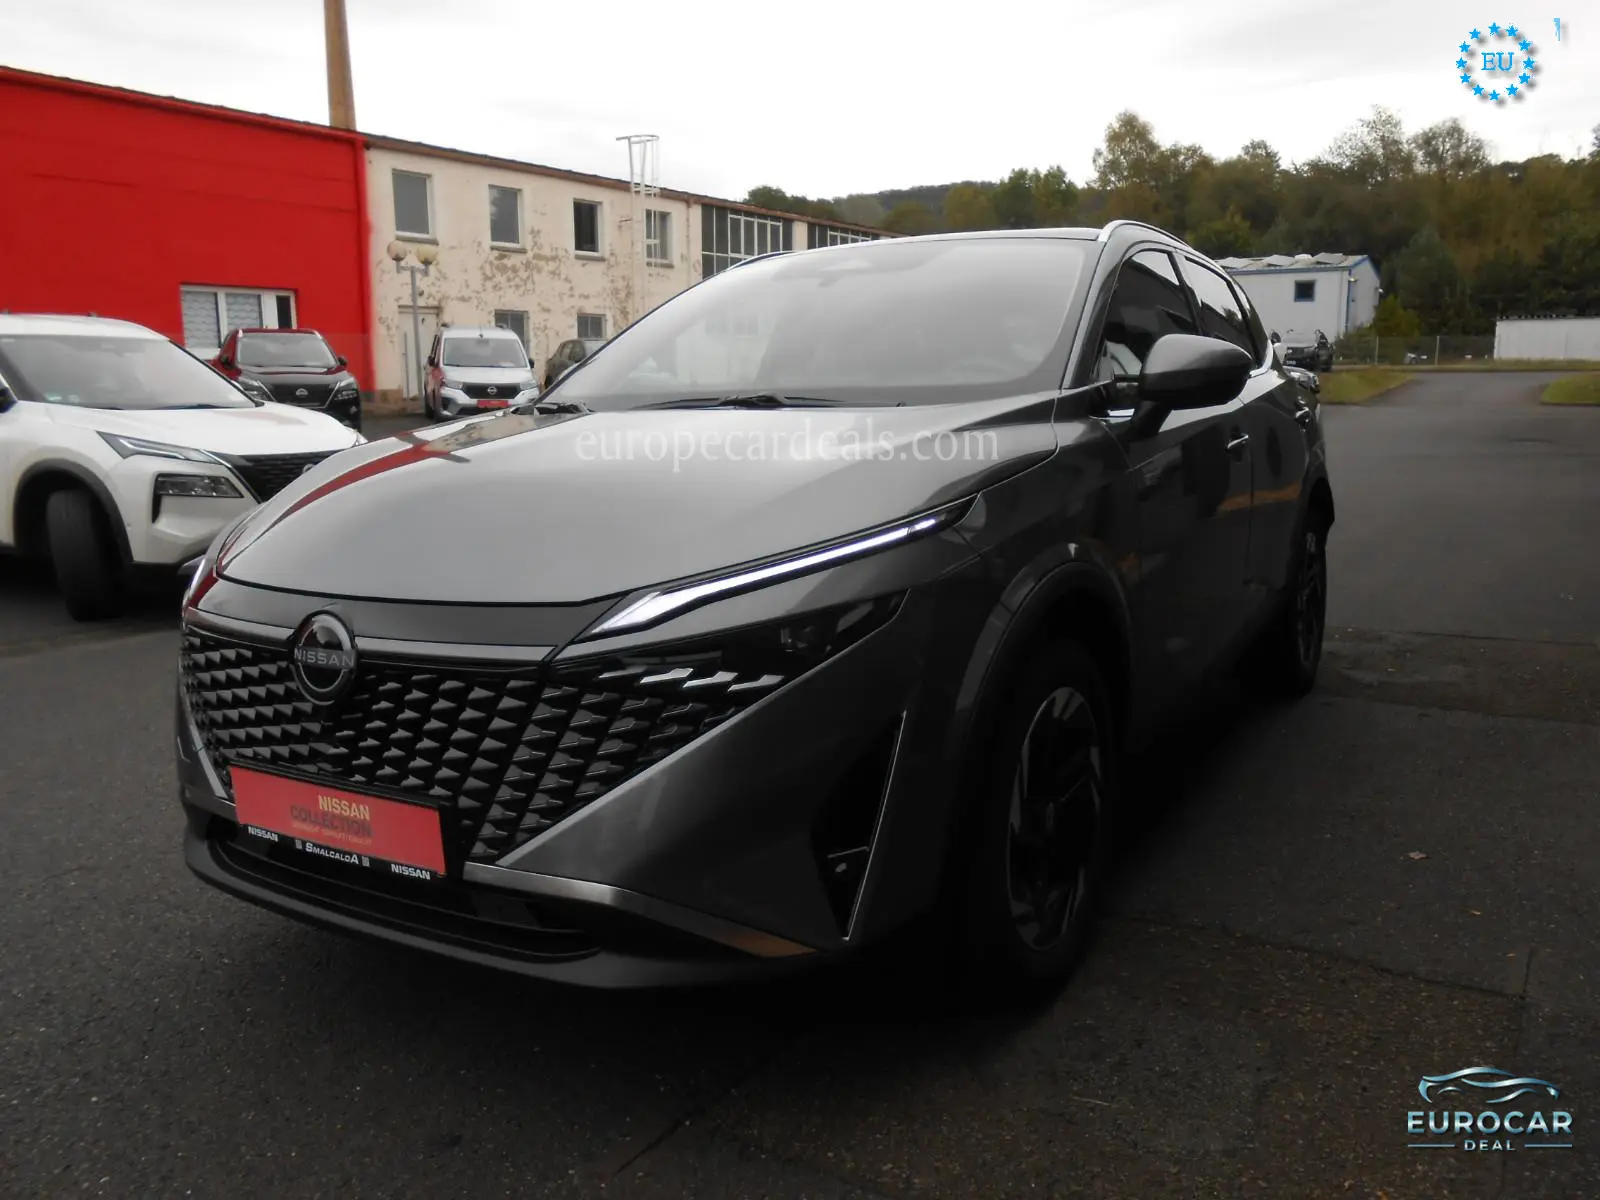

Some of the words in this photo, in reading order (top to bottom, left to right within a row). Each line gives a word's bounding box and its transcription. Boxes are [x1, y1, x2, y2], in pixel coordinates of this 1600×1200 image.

[294, 648, 354, 666] NISSAN
[290, 805, 373, 836] COLLECTION
[318, 795, 370, 820] NISSAN
[247, 826, 279, 842] NISSAN
[391, 863, 431, 880] NISSAN
